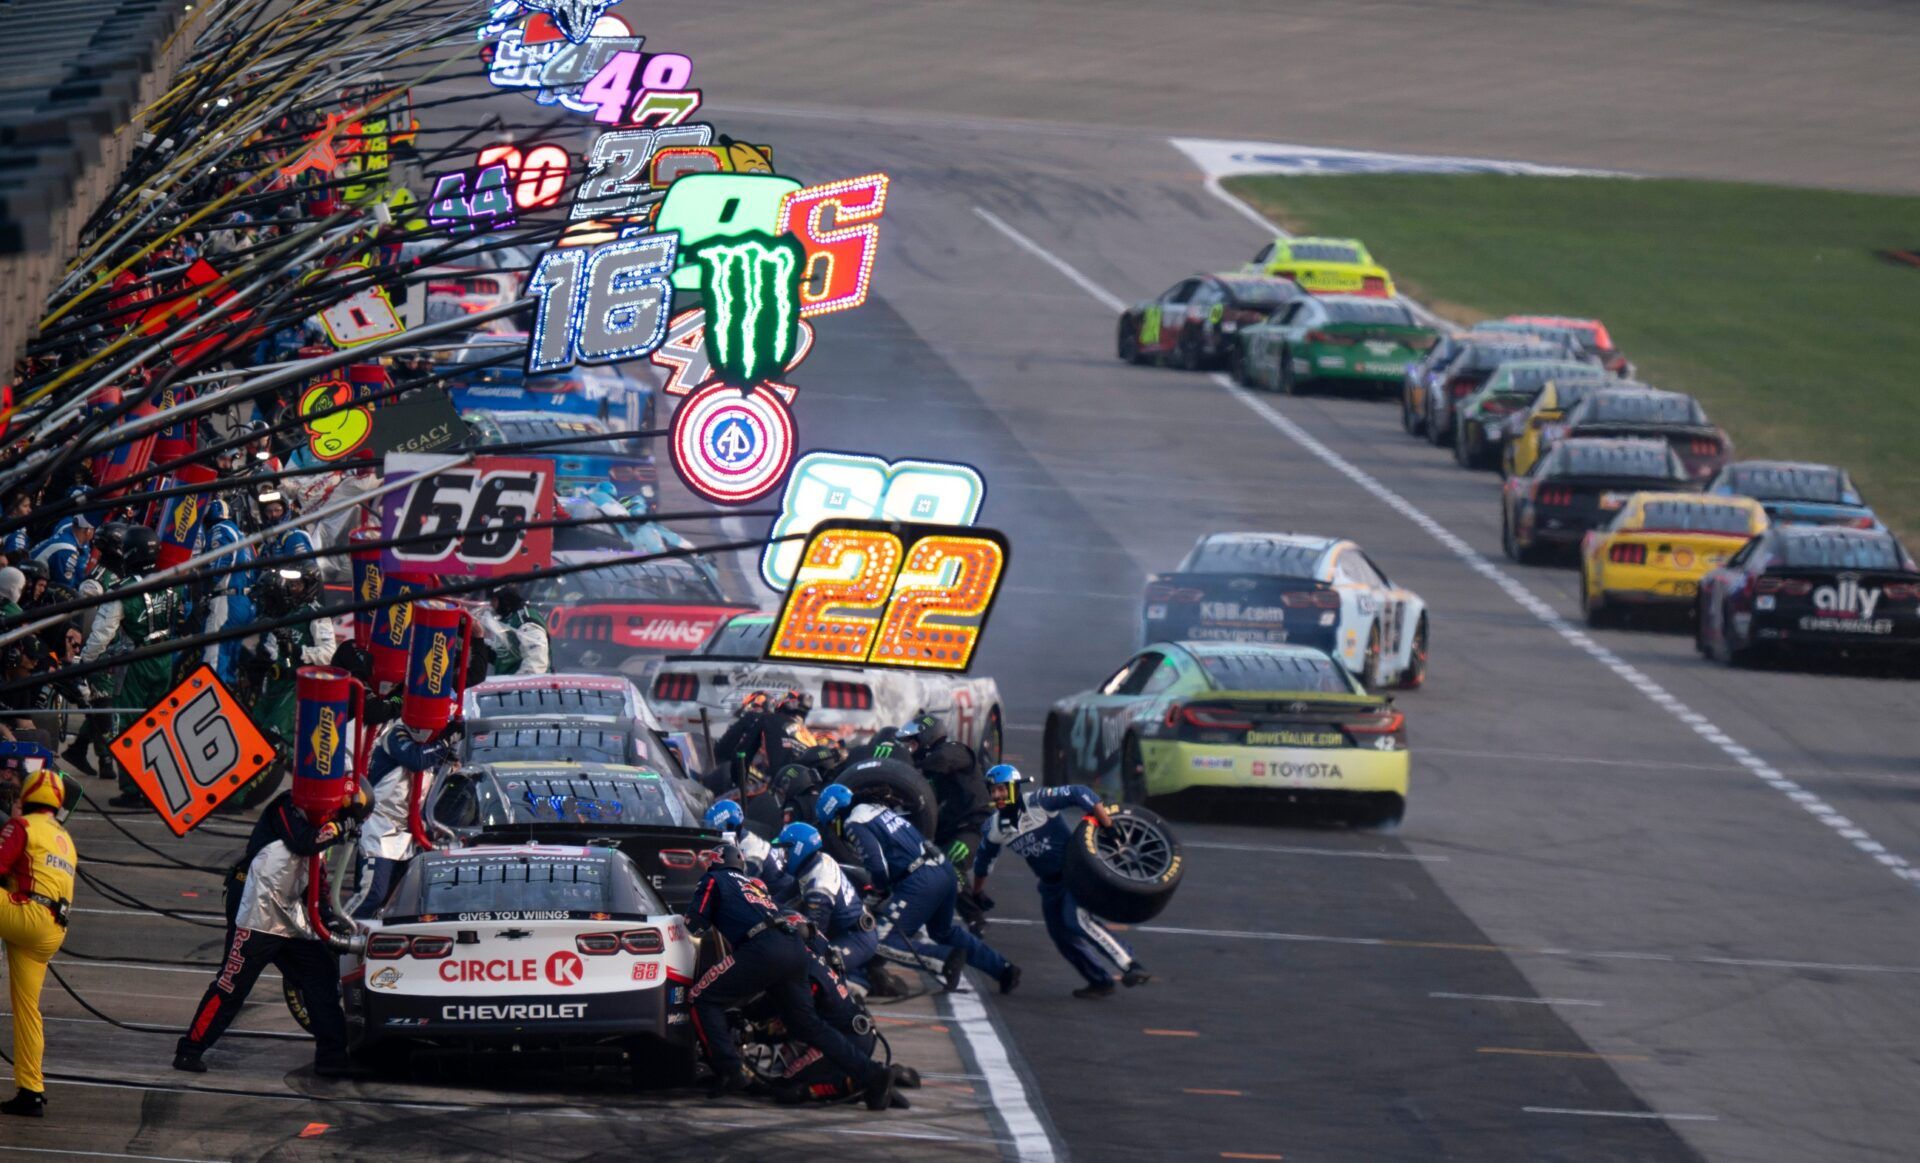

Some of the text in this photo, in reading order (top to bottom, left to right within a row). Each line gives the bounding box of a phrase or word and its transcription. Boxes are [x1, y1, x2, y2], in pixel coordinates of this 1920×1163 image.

[526, 232, 680, 372] 16
[392, 469, 546, 565] 66
[770, 530, 1003, 669] 22
[1813, 580, 1881, 619] ally
[429, 634, 446, 693] SUNOCO
[141, 686, 239, 817] 16
[316, 708, 334, 774] SUNOCO
[1374, 736, 1396, 750] 42
[1269, 763, 1343, 778] TOYOTA
[459, 912, 491, 921] GIVES
[495, 911, 519, 921] YOU
[438, 960, 537, 983] CIRCLE
[442, 1003, 588, 1020] CHEVROLET
